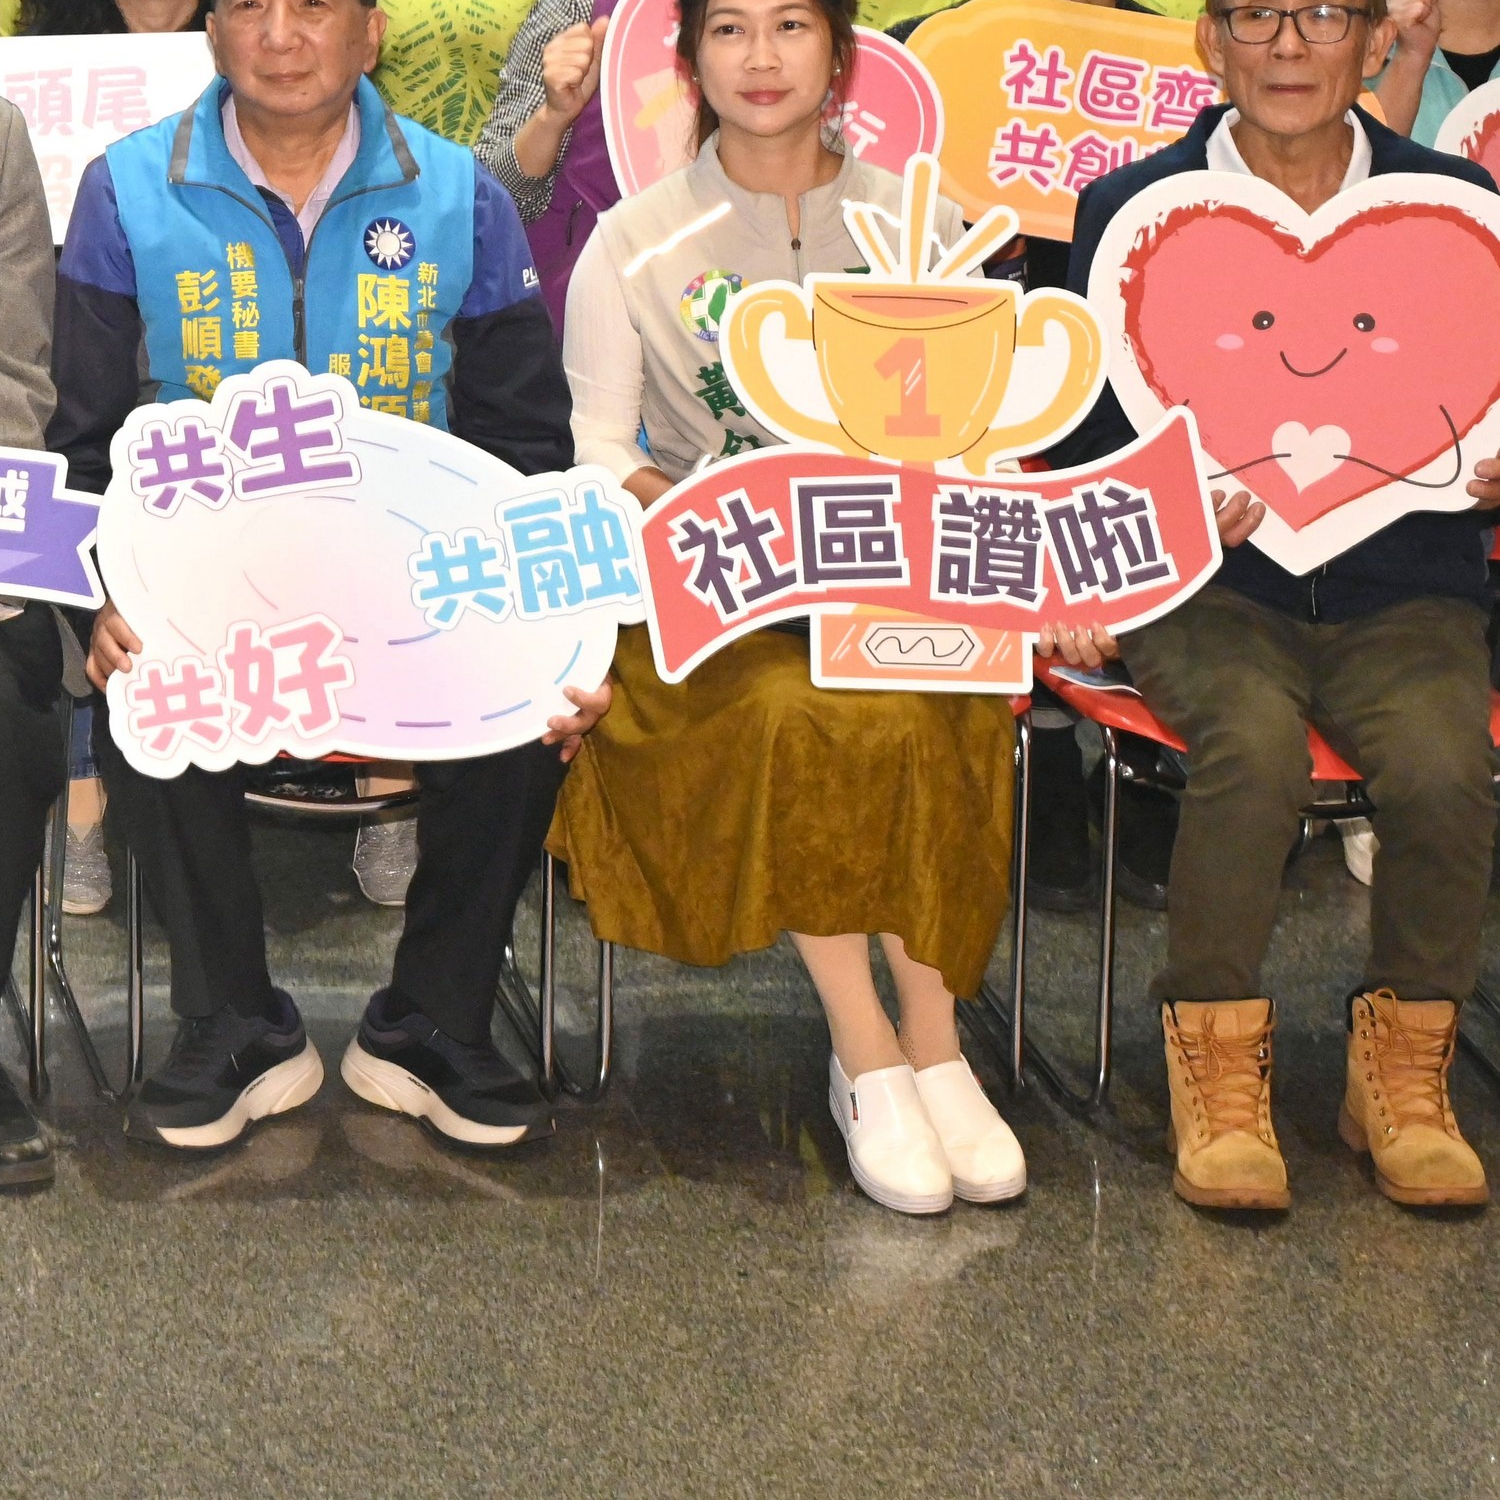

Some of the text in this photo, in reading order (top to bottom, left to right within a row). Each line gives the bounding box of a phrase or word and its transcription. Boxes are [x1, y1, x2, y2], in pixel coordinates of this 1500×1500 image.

[995, 121, 1165, 194] 共創
[225, 241, 261, 359] 機要秘書
[138, 384, 359, 509] 共生
[872, 337, 942, 437] 1
[417, 487, 641, 622] 共融
[135, 623, 353, 752] 共好
